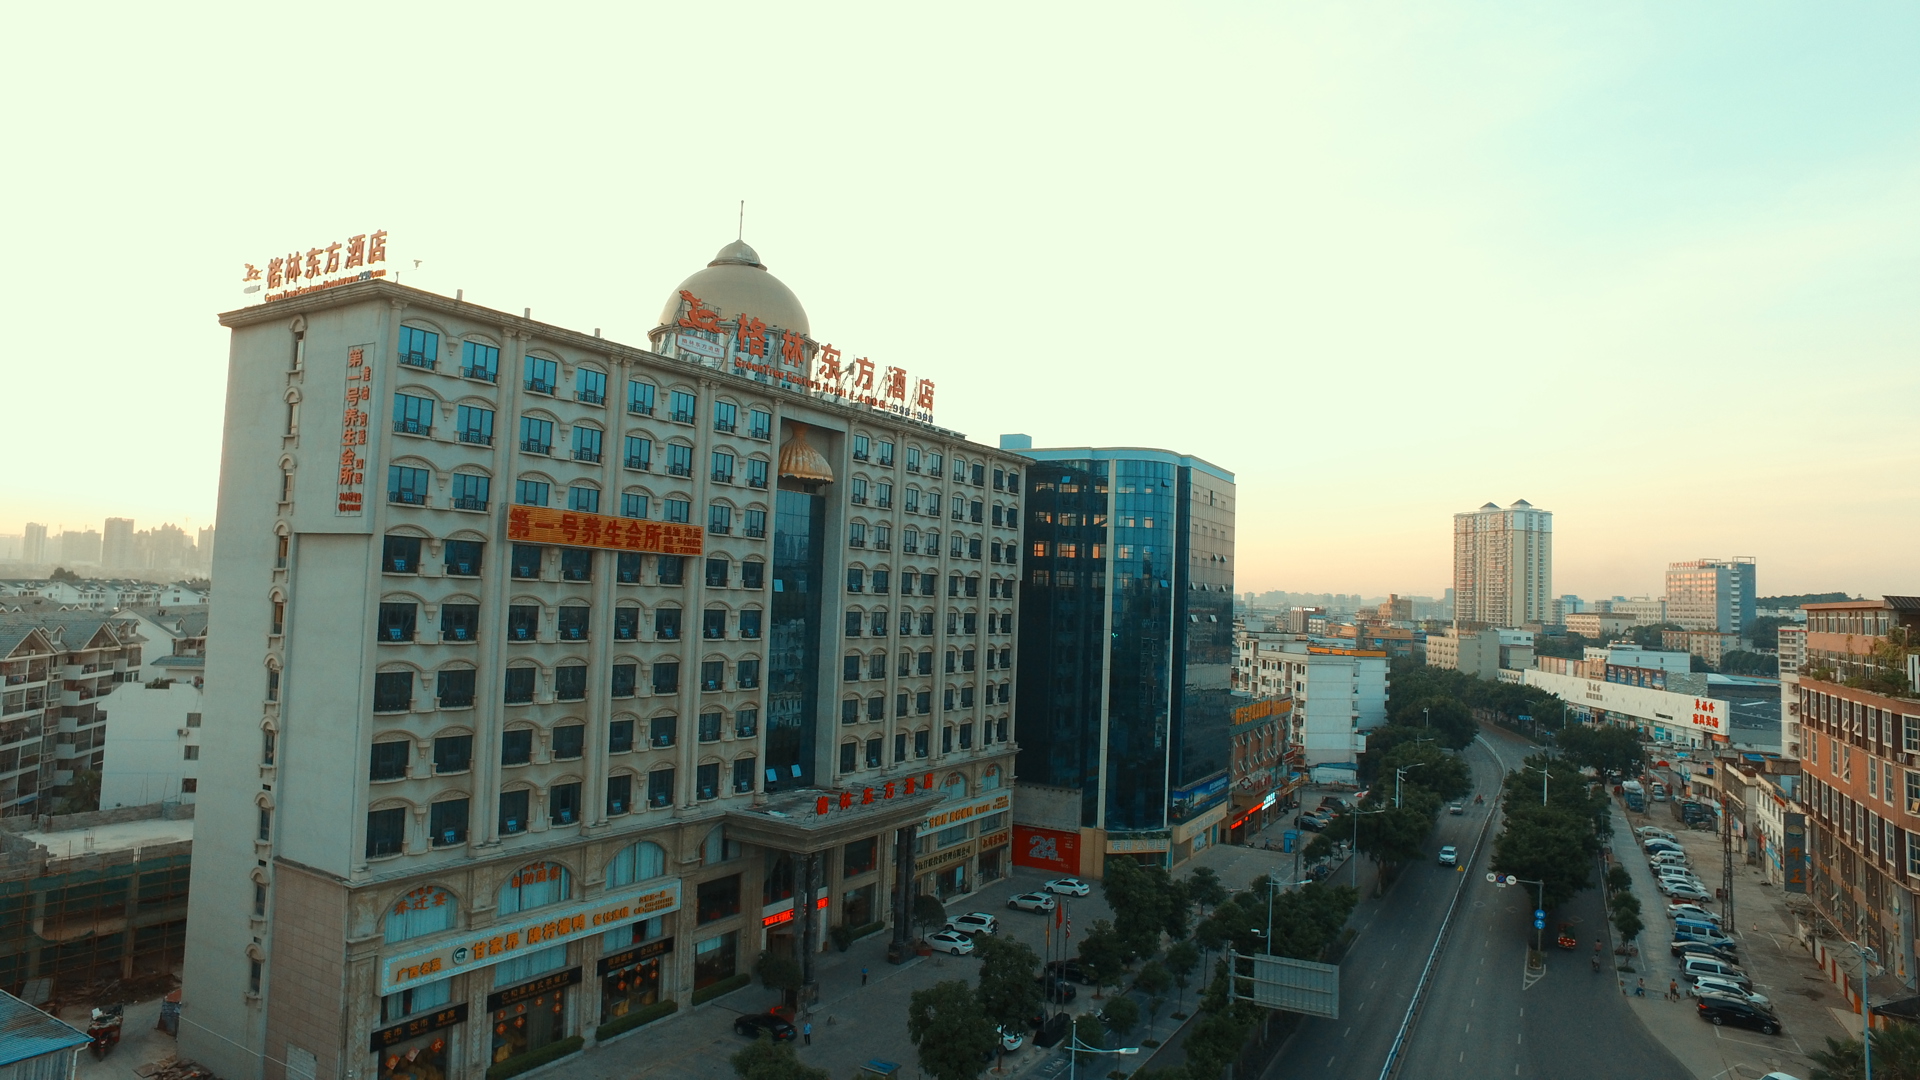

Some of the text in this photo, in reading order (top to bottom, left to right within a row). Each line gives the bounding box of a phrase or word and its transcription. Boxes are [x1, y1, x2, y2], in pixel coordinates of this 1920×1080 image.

[267, 229, 388, 289] 格林东方酒店
[736, 313, 935, 411] 格林东方酒店
[338, 348, 364, 485] 第一号养生会所
[509, 508, 662, 551] 第一号养生会所
[816, 773, 934, 815] 格林东方酒店
[1029, 835, 1059, 860] 24
[396, 906, 629, 981] 广西名菜 甘家界 牌柠檬鸭 餐饮连锁
